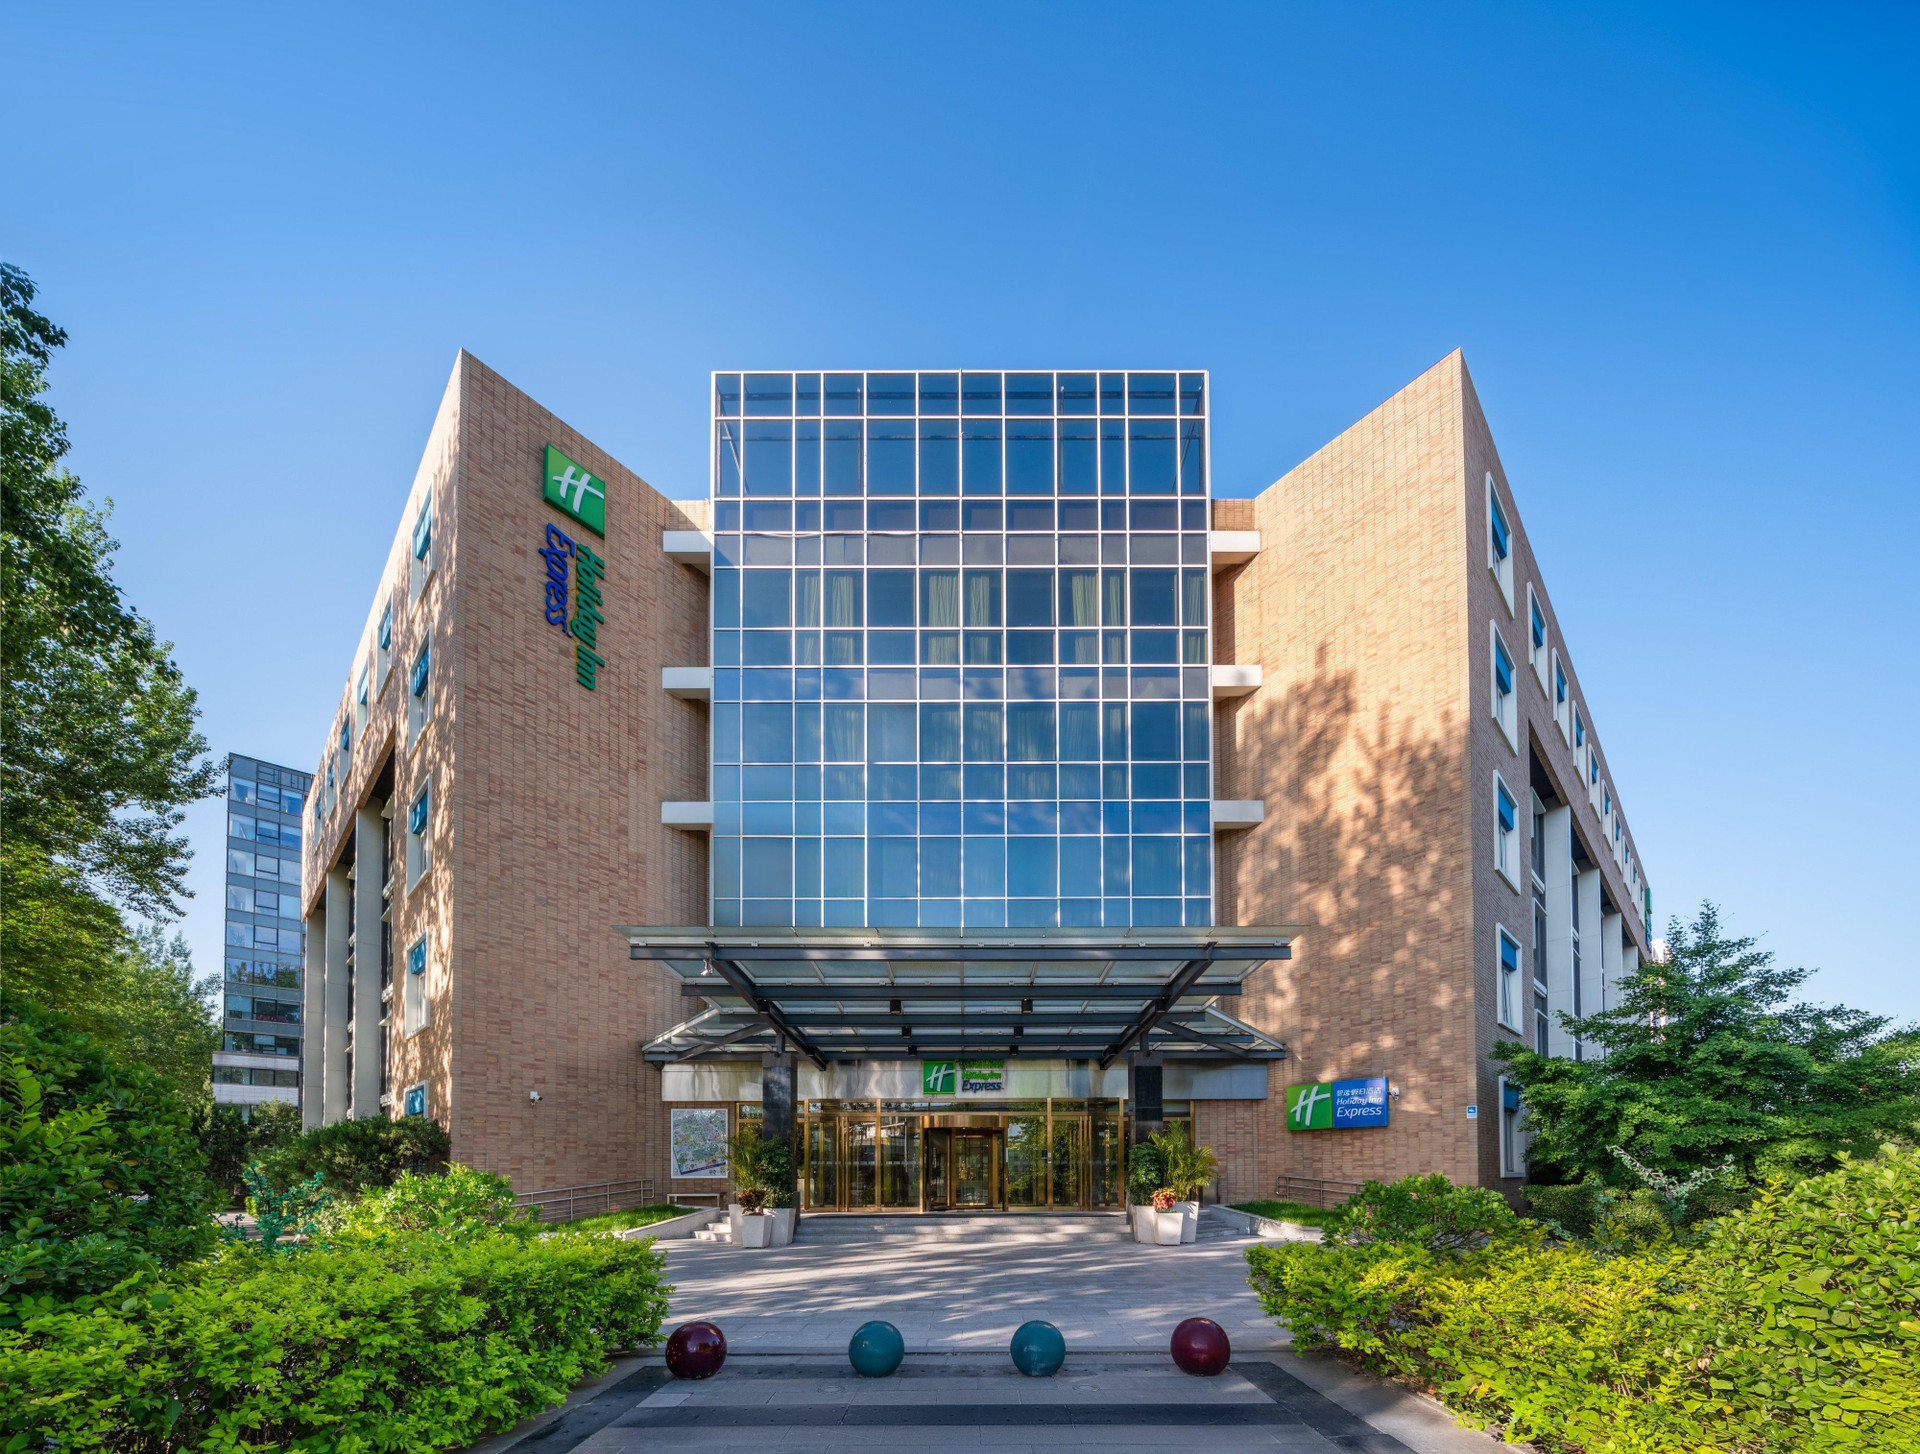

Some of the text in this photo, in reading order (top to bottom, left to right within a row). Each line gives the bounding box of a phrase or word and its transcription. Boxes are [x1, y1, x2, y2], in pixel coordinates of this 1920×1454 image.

[538, 523, 575, 633] Express
[571, 543, 605, 691] Holiday Inn
[961, 1080, 1002, 1093] Express
[1336, 1097, 1368, 1106] Holiday
[1336, 1106, 1382, 1119] Express
